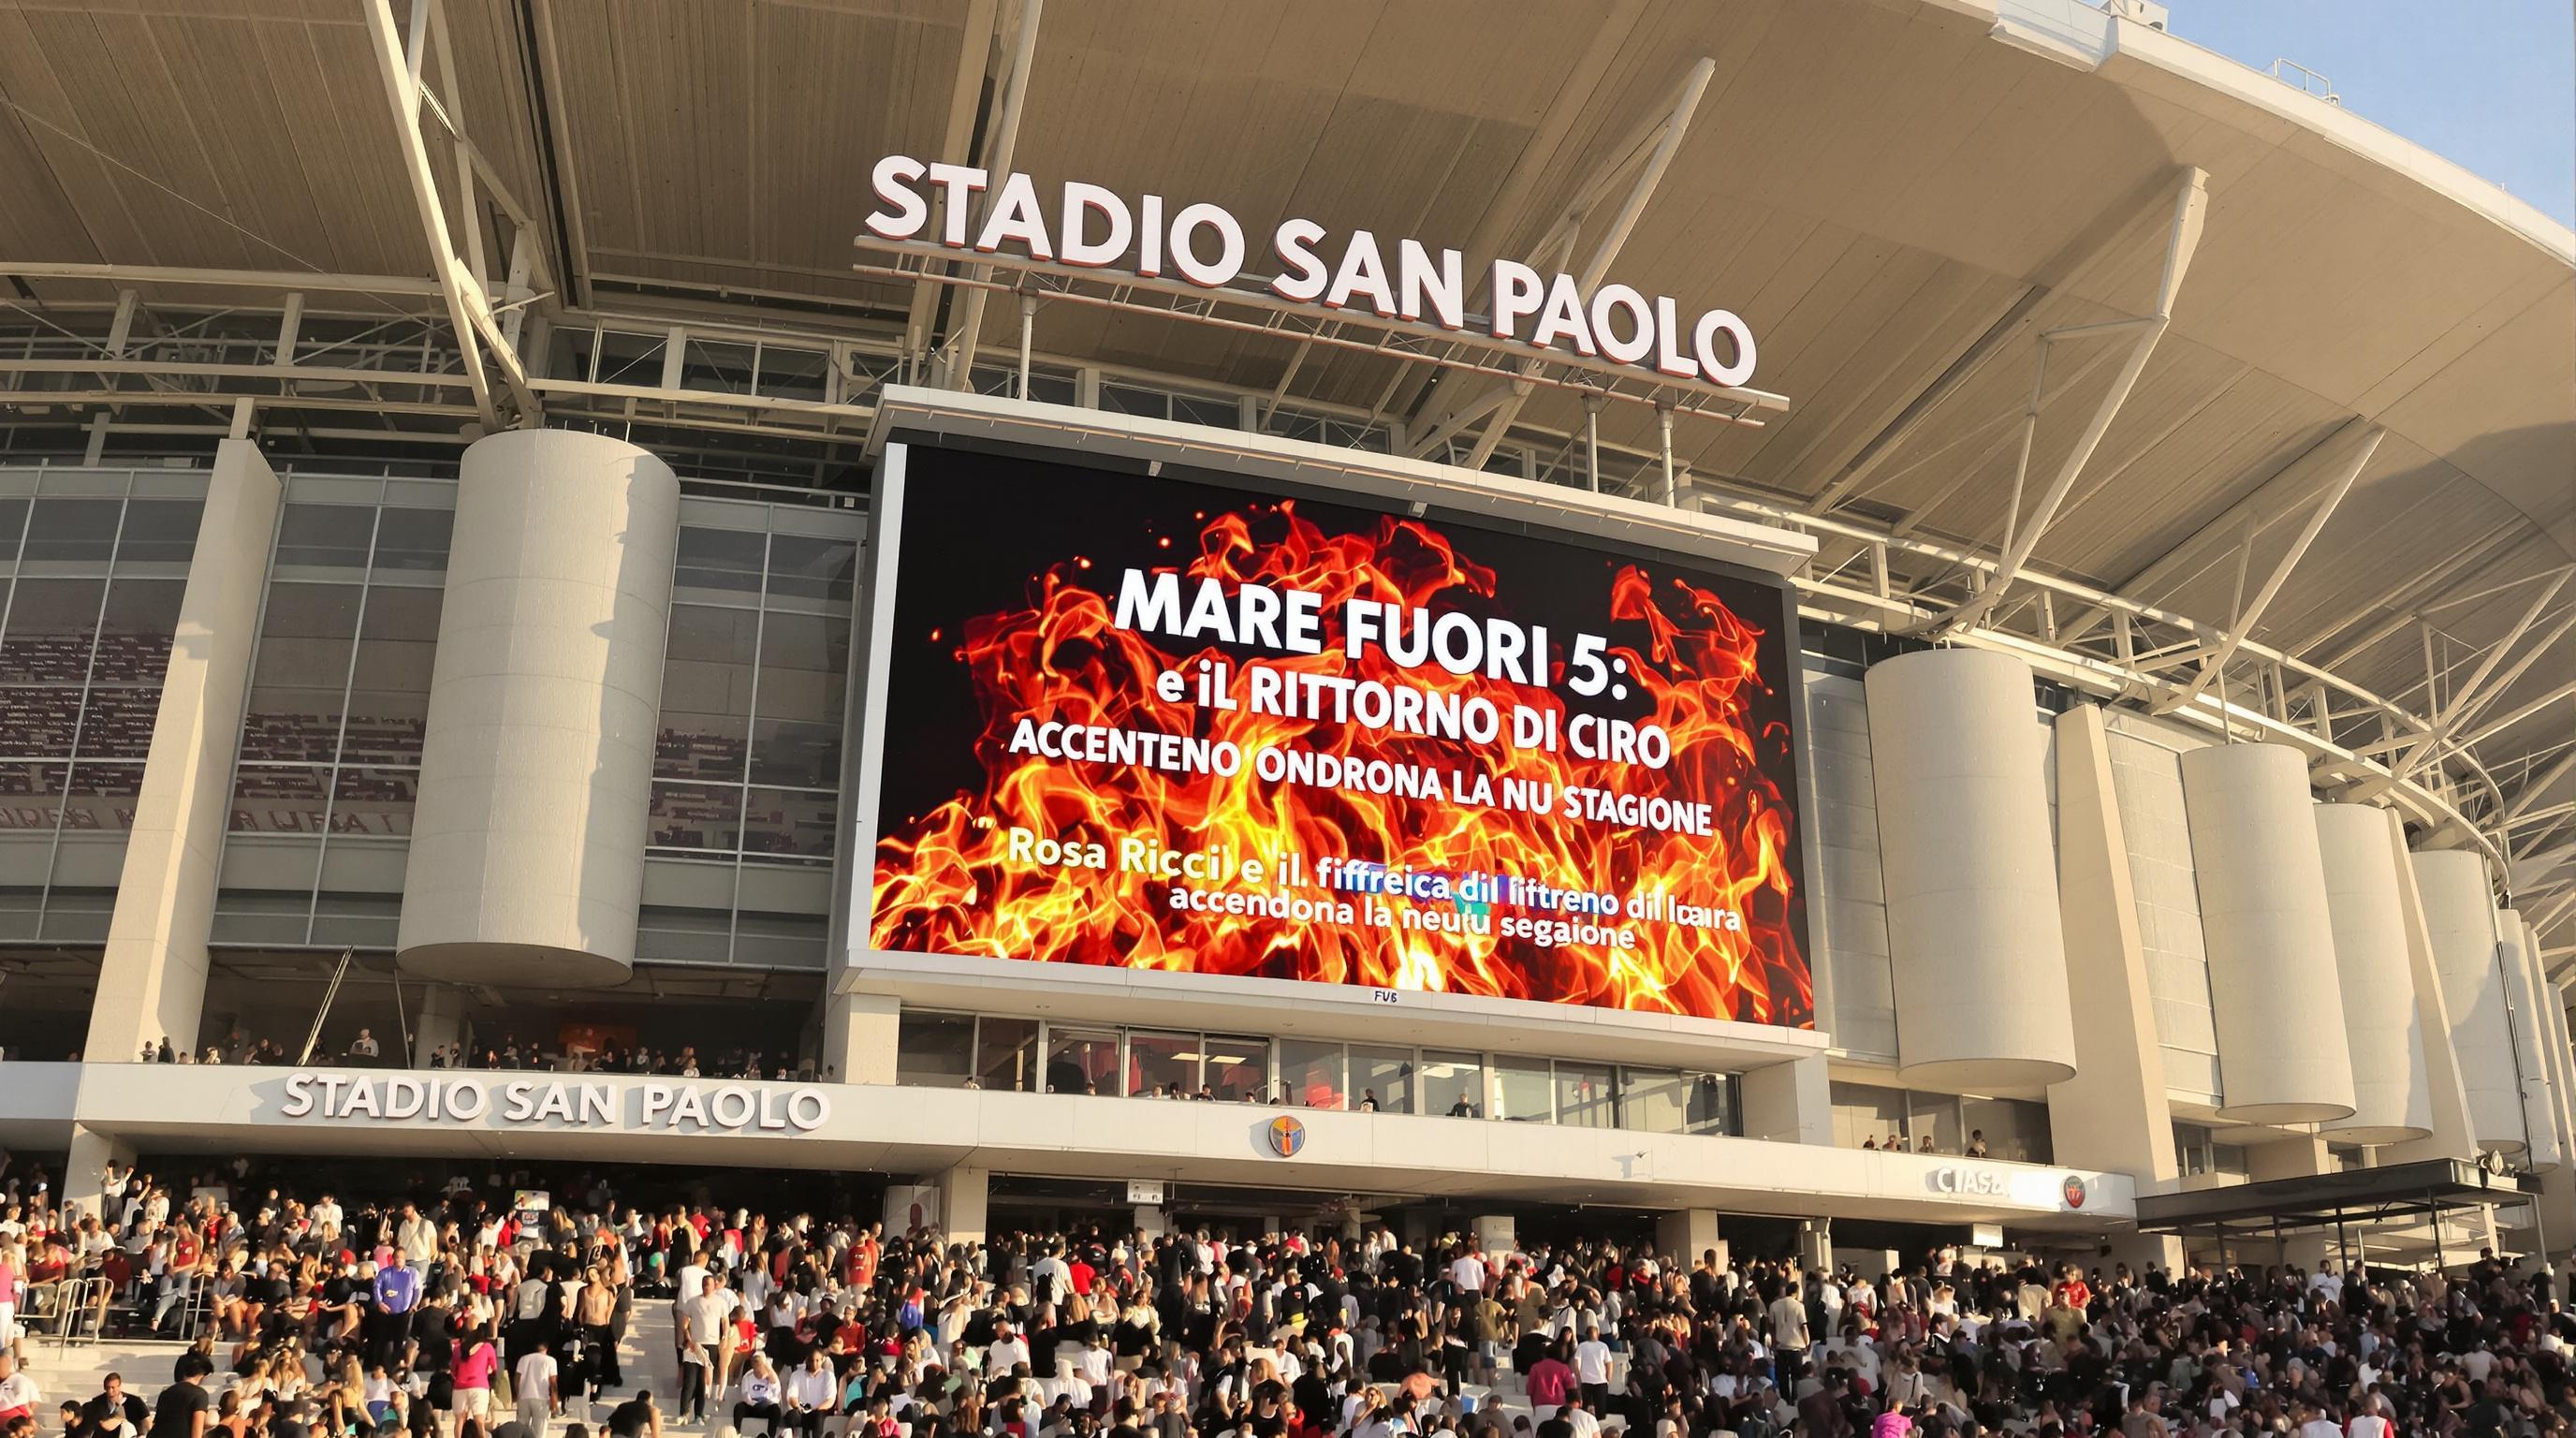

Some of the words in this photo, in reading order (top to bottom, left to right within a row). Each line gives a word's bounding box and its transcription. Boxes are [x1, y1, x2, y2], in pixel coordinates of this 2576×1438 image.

[865, 154, 1246, 288] STADIO
[1272, 218, 1463, 330] SAN
[1491, 259, 1757, 389] PAOLO
[1115, 567, 1323, 653] MARE
[1346, 598, 1548, 688] FUORI
[1569, 633, 1630, 700] 5:
[1157, 668, 1184, 703] e
[1251, 666, 1500, 745] RITTORNO
[1514, 702, 1556, 752] DI
[1569, 714, 1670, 770] CIRO
[1008, 718, 1242, 777] ACCENTENO
[1255, 746, 1445, 801] ONDRONA
[1453, 770, 1495, 808] LA
[1503, 777, 1552, 815] NU
[1562, 786, 1712, 838] STAGIONE
[1008, 826, 1106, 870] Rosa
[1240, 858, 1264, 884] e
[1169, 886, 1354, 925] accendona
[1364, 896, 1392, 928] la
[281, 1073, 488, 1121] STADIO
[503, 1081, 616, 1123] SAN
[641, 1085, 831, 1129] PAOLO
